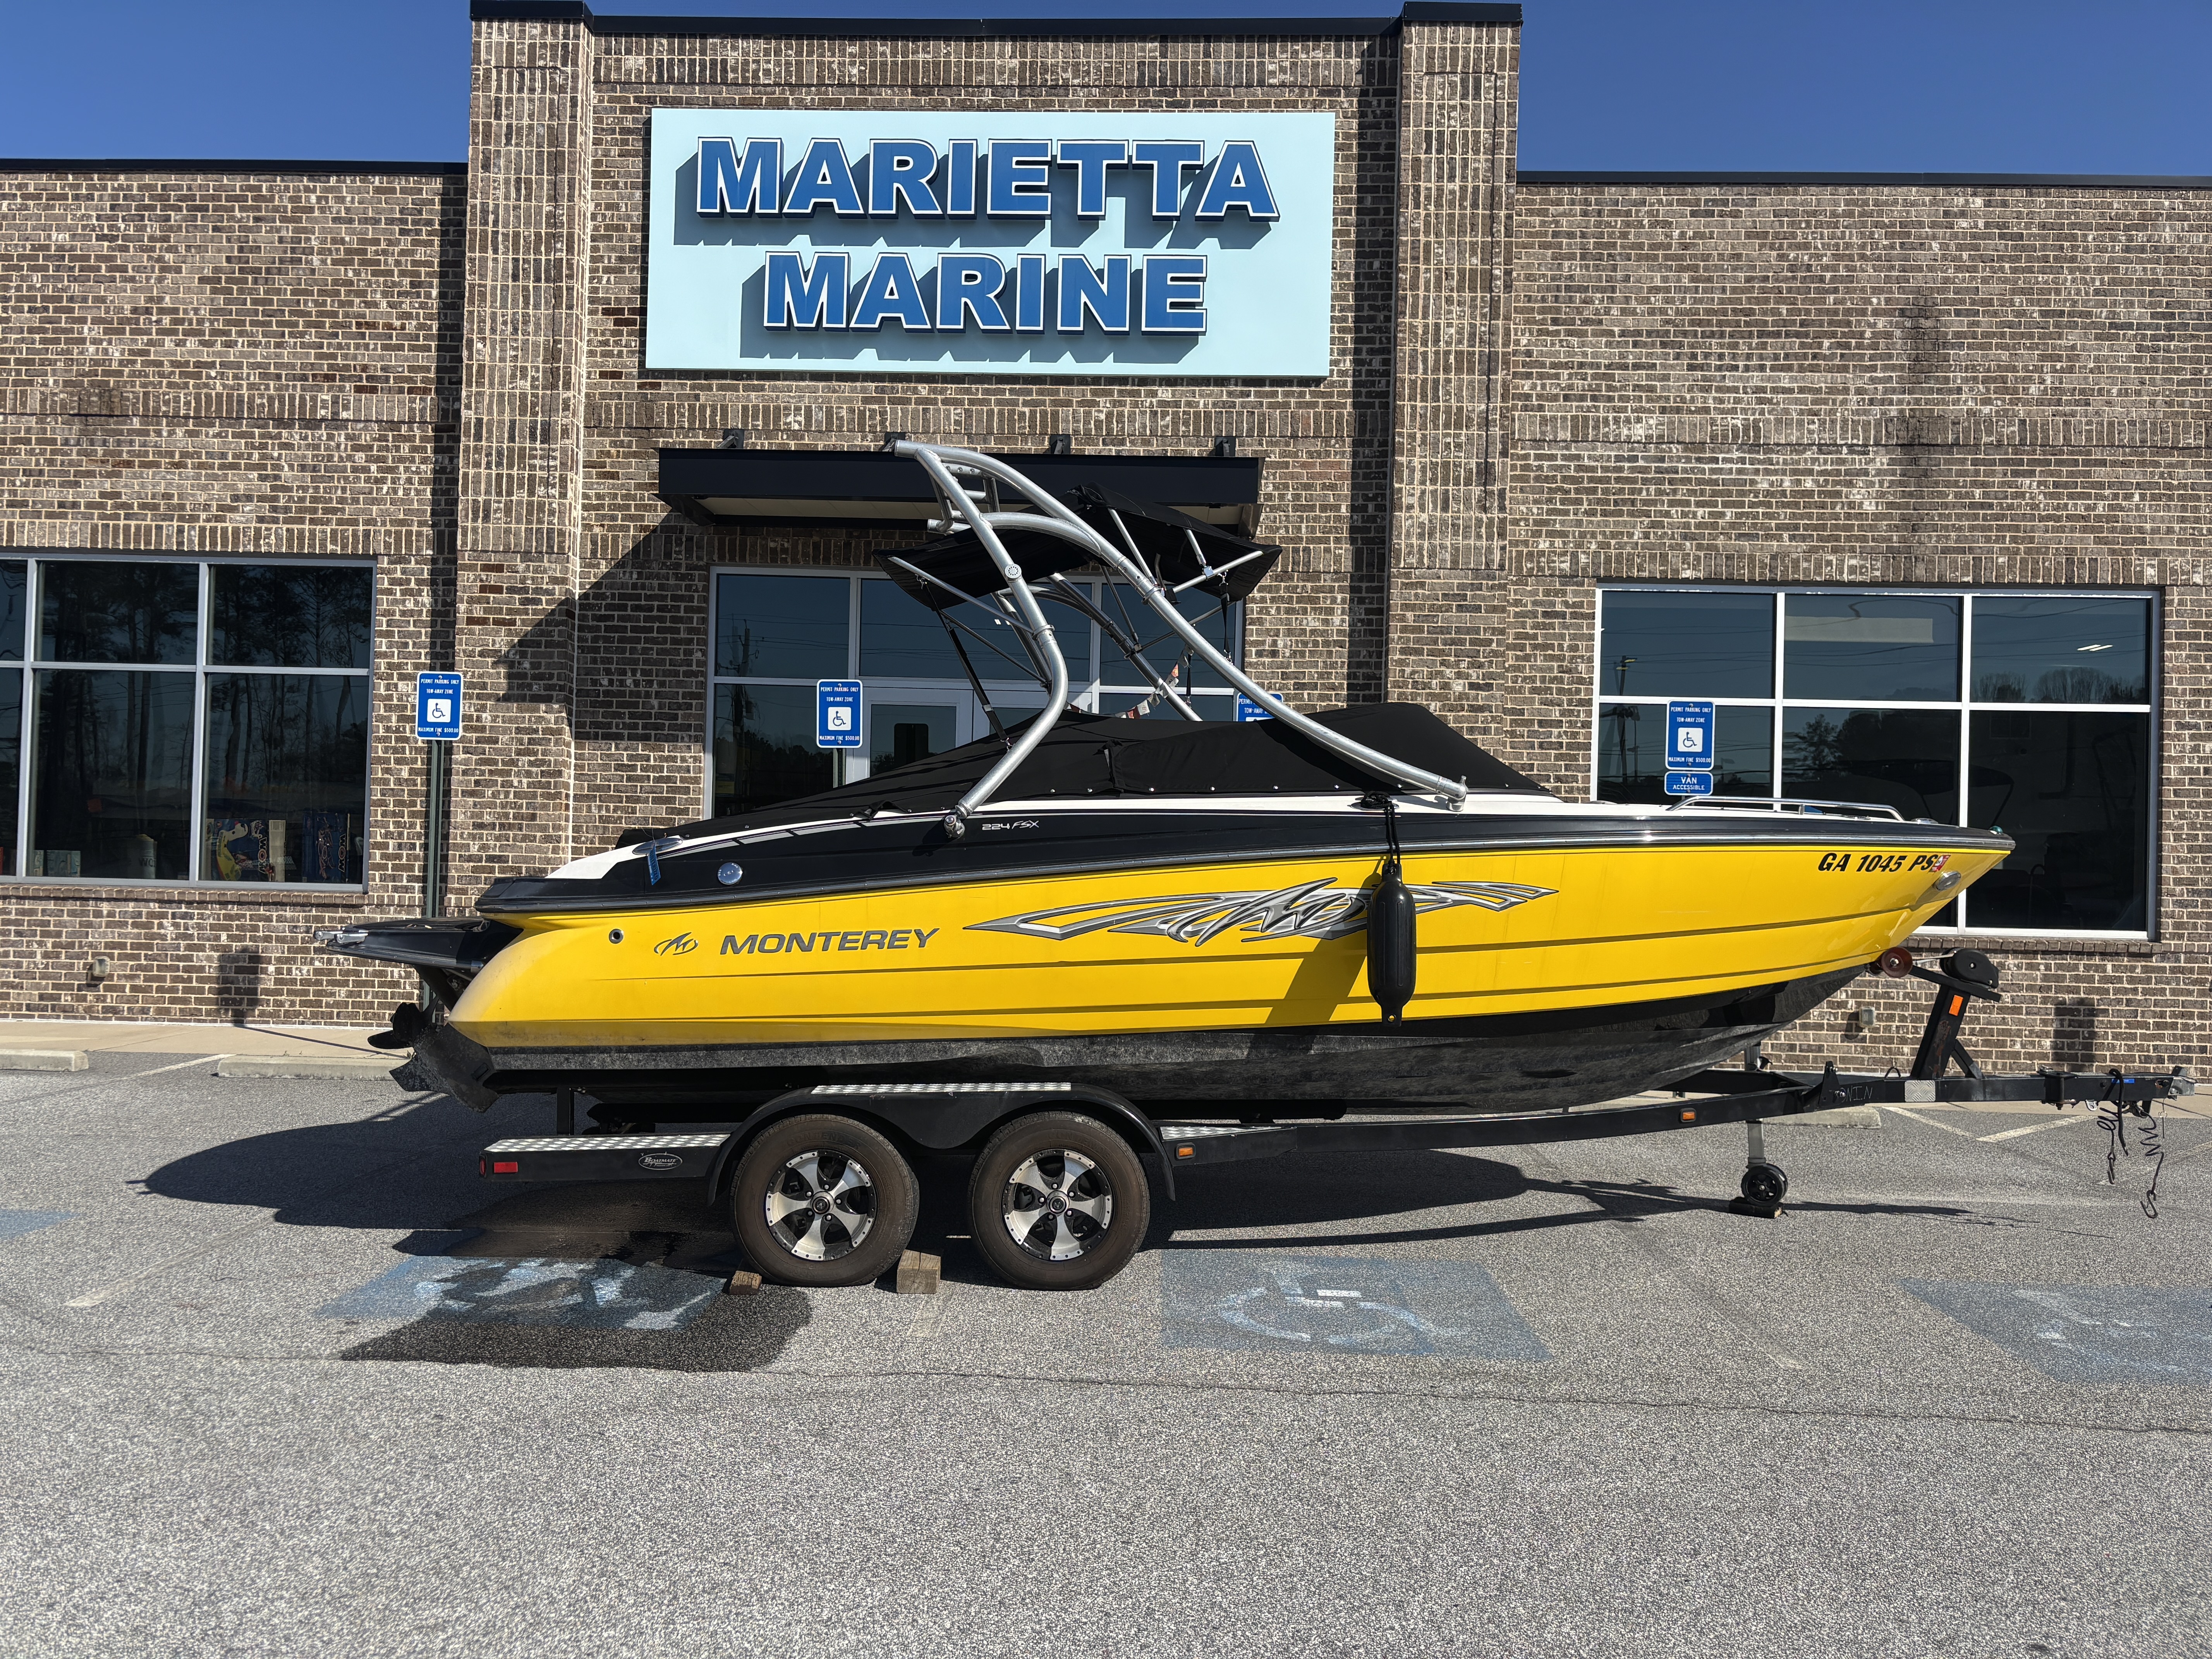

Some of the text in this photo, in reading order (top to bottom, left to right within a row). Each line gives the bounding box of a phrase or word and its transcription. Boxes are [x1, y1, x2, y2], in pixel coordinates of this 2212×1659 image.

[696, 136, 1280, 222] MARIETTA
[763, 250, 1207, 335] MARINE
[1012, 820, 1039, 829] FSX
[338, 833, 346, 872] WOW
[1818, 852, 1938, 872] GA 1045 PS
[720, 928, 940, 955] MONTEREY
